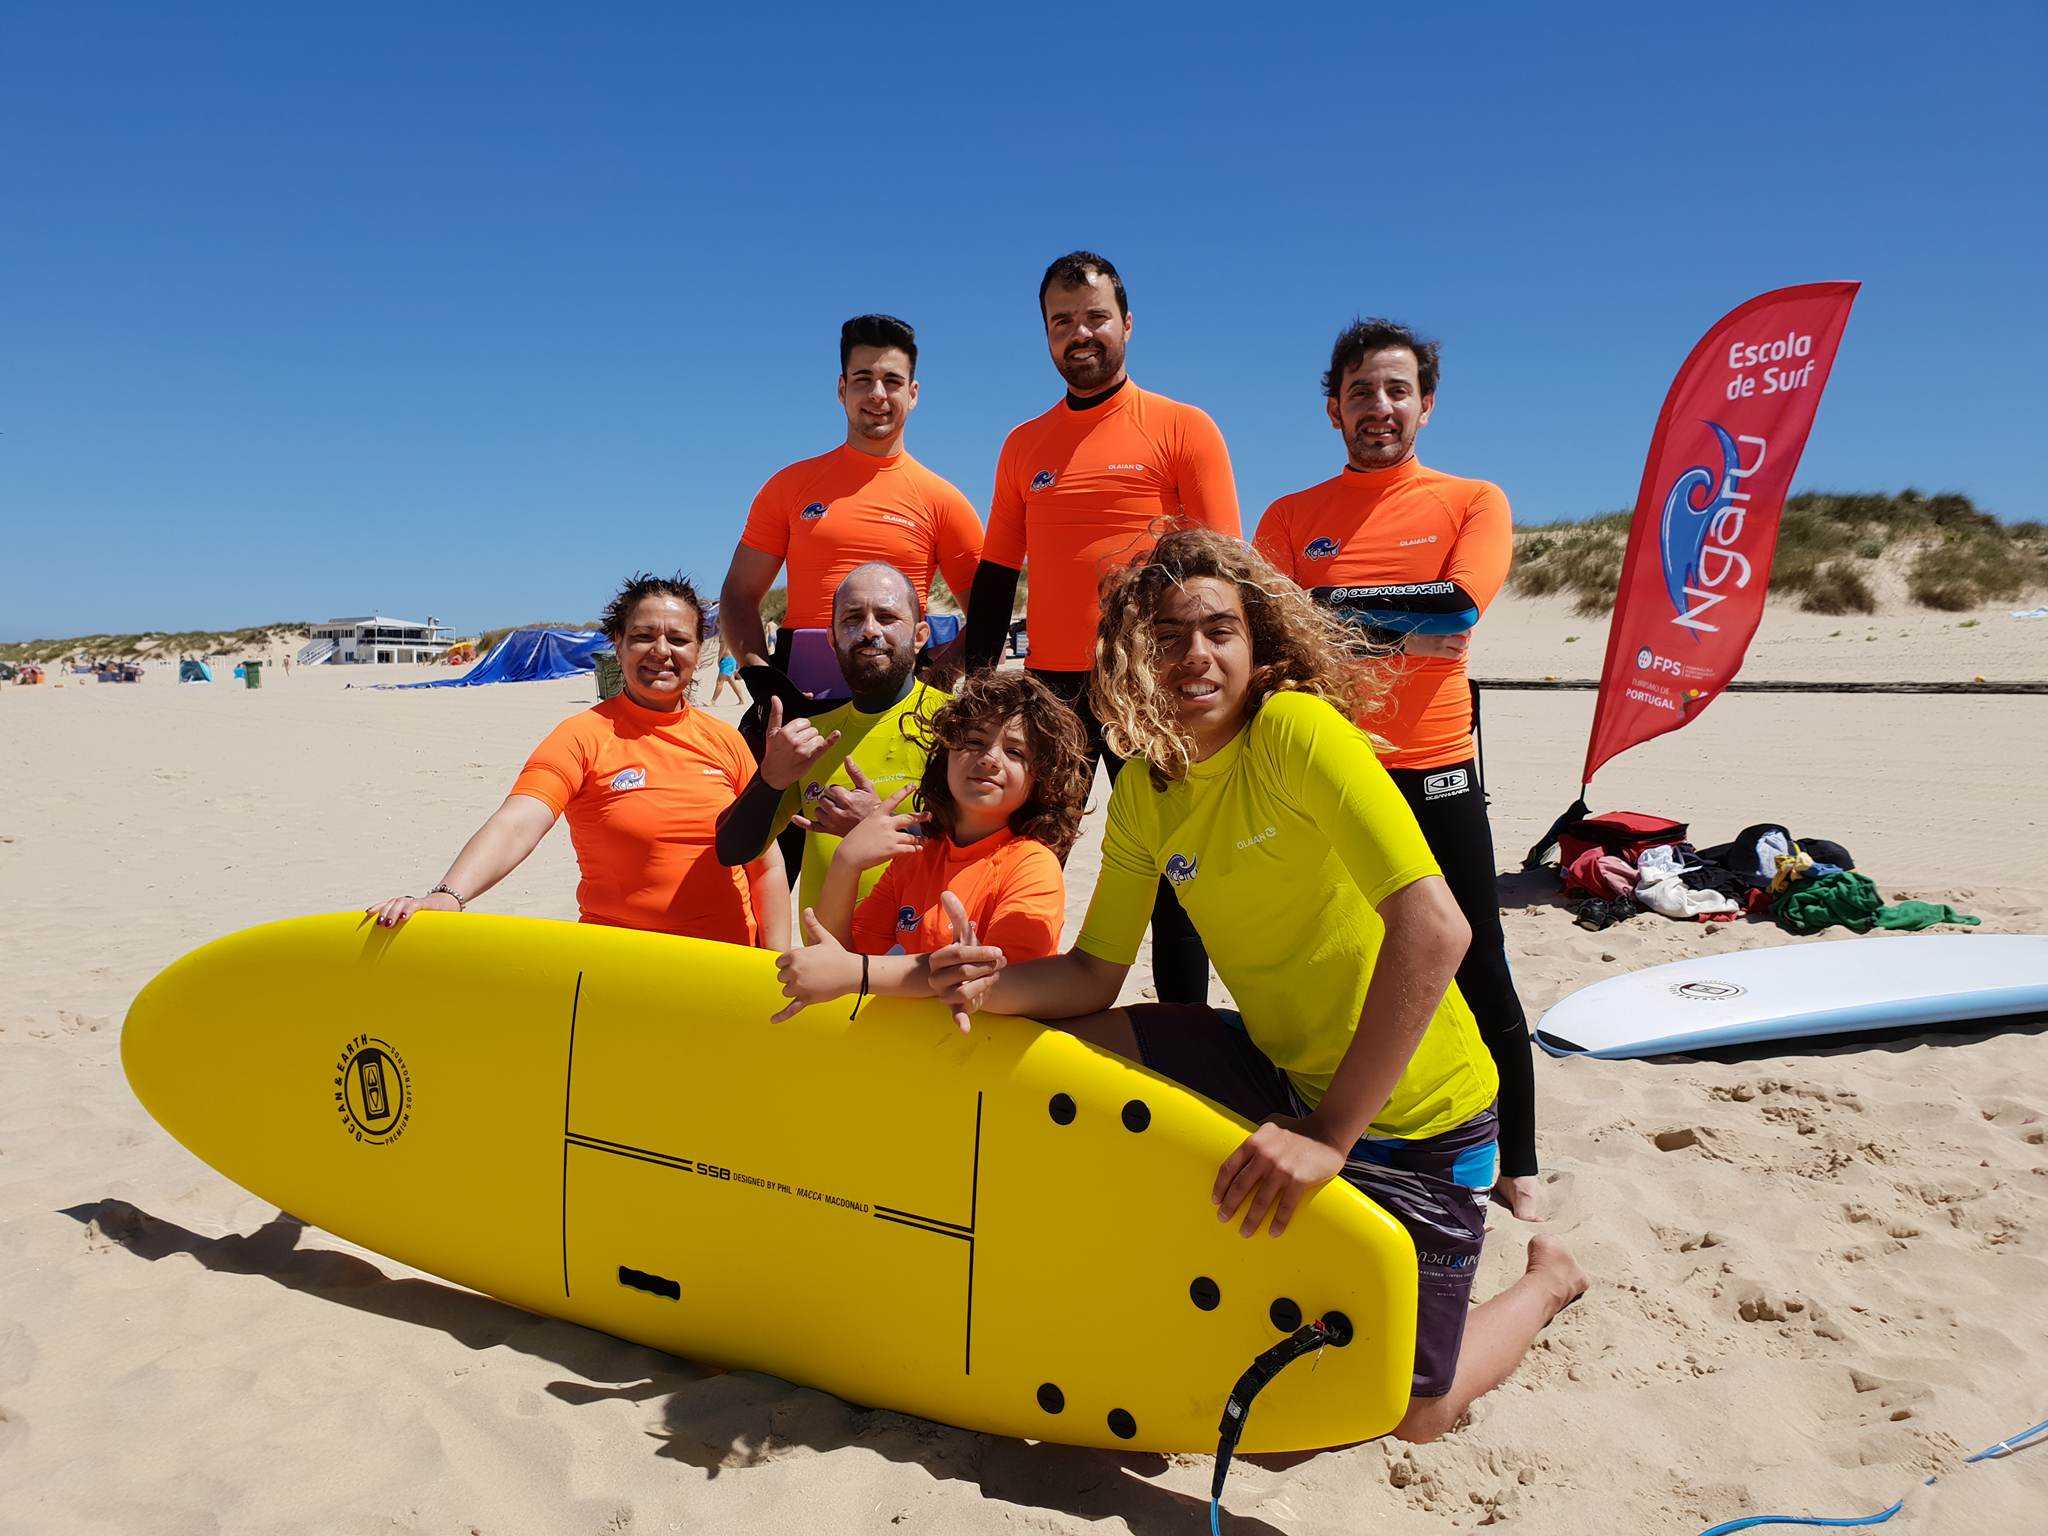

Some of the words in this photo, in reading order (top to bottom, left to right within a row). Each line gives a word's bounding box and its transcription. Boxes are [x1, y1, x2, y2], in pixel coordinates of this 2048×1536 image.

[1729, 331, 1811, 369] Escola
[1726, 373, 1756, 401] de
[1762, 359, 1815, 394] Surf
[1652, 655, 1682, 676] FPS
[1625, 687, 1676, 710] PORTUGAL
[336, 1033, 368, 1072] EARTH
[335, 1076, 343, 1087] &
[335, 1092, 362, 1142] OCEAN
[697, 1162, 731, 1181] SSB
[733, 1173, 766, 1188] DESIGNED
[767, 1180, 776, 1190] BY
[777, 1183, 793, 1195] PHIL
[825, 1194, 869, 1213] MACDONALD
